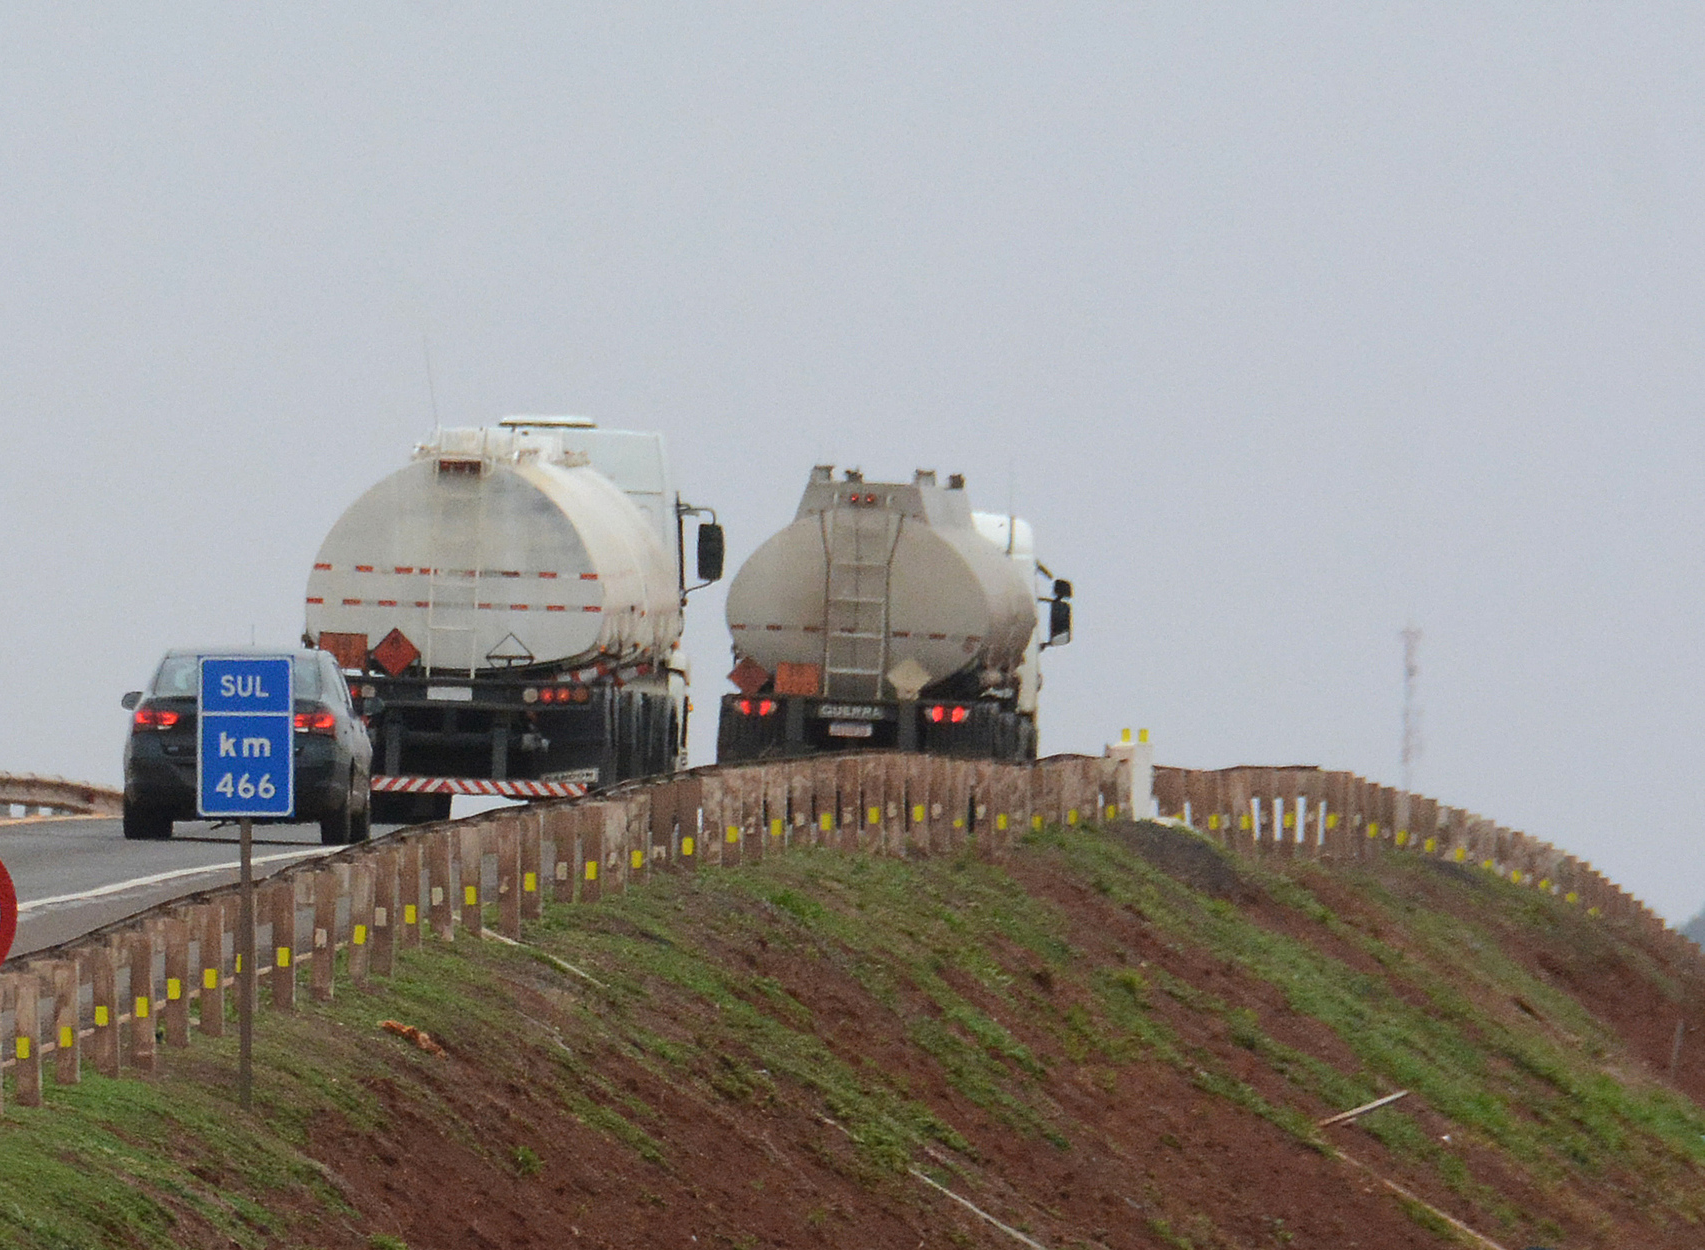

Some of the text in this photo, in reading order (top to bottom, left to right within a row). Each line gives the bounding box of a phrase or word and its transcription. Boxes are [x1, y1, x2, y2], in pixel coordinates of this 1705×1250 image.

[220, 674, 270, 698] SUL
[218, 731, 272, 758] km
[215, 772, 276, 799] 466
